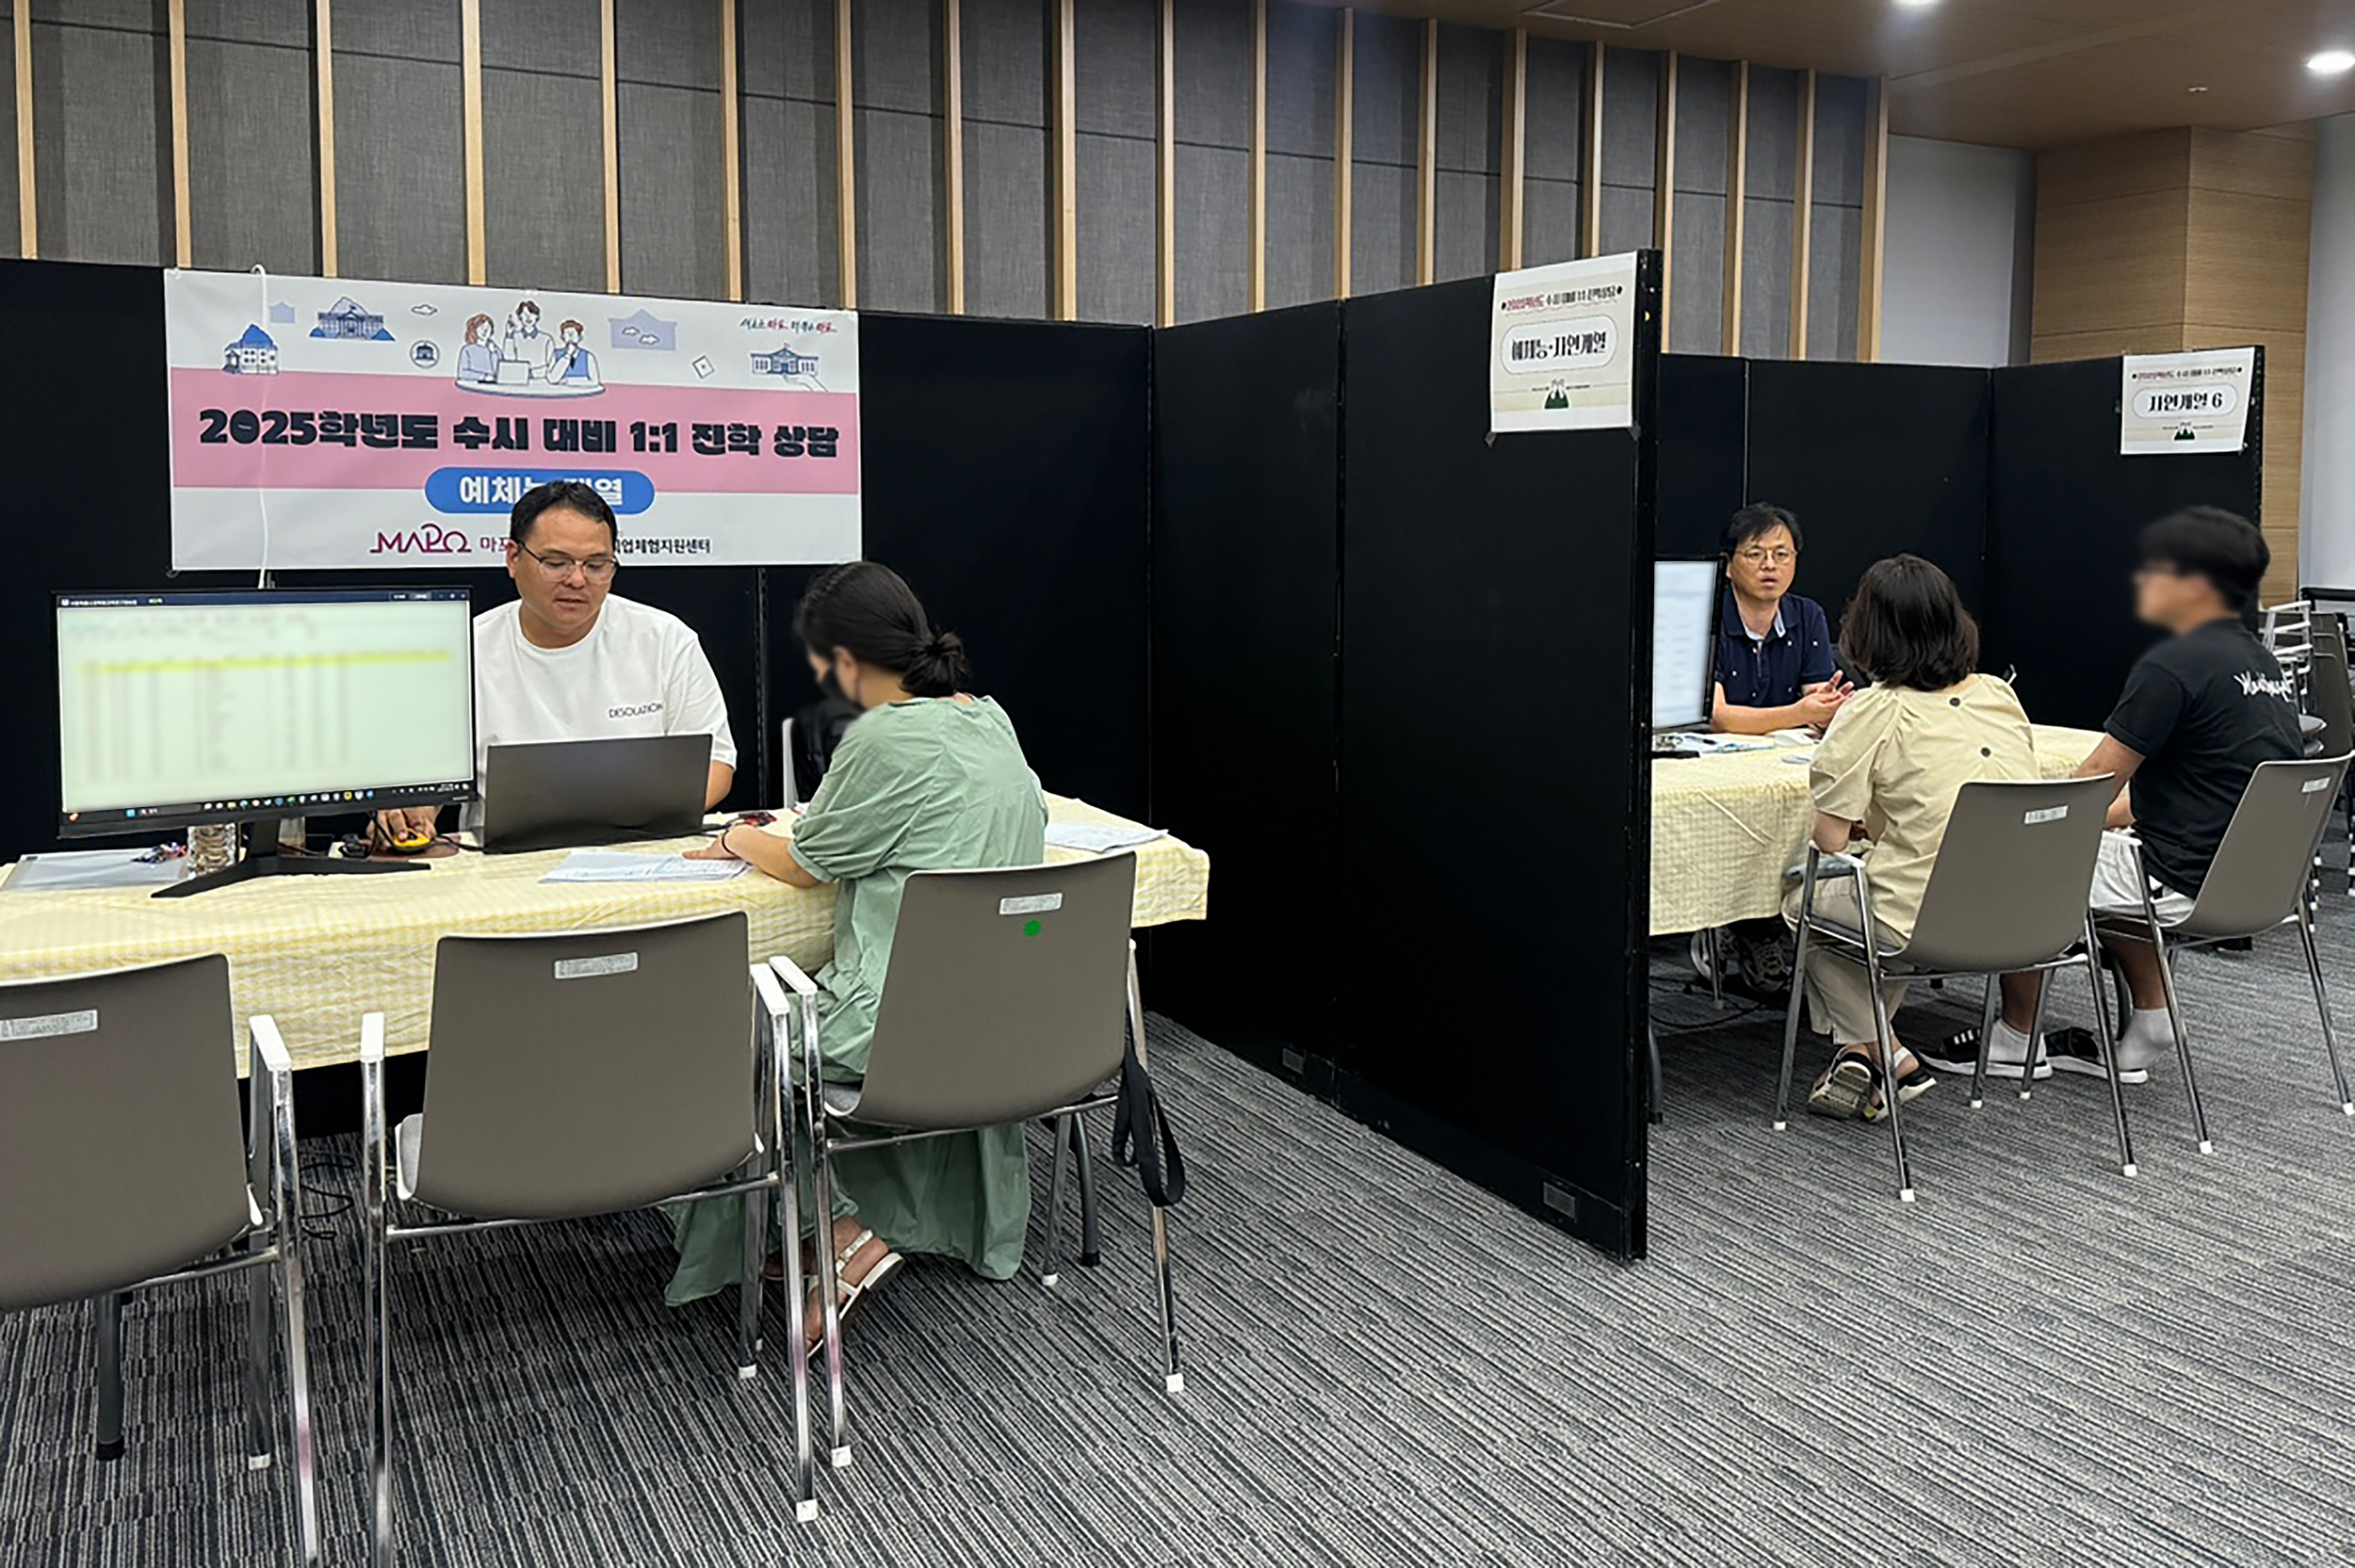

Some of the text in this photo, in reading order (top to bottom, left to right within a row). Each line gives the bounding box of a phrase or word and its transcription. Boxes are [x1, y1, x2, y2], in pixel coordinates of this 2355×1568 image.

[2211, 392, 2223, 409] 6
[199, 408, 839, 458] 2025학년도 수시 대비 1:1 진학 상담
[562, 477, 624, 506] 열
[369, 523, 472, 554] MAPO
